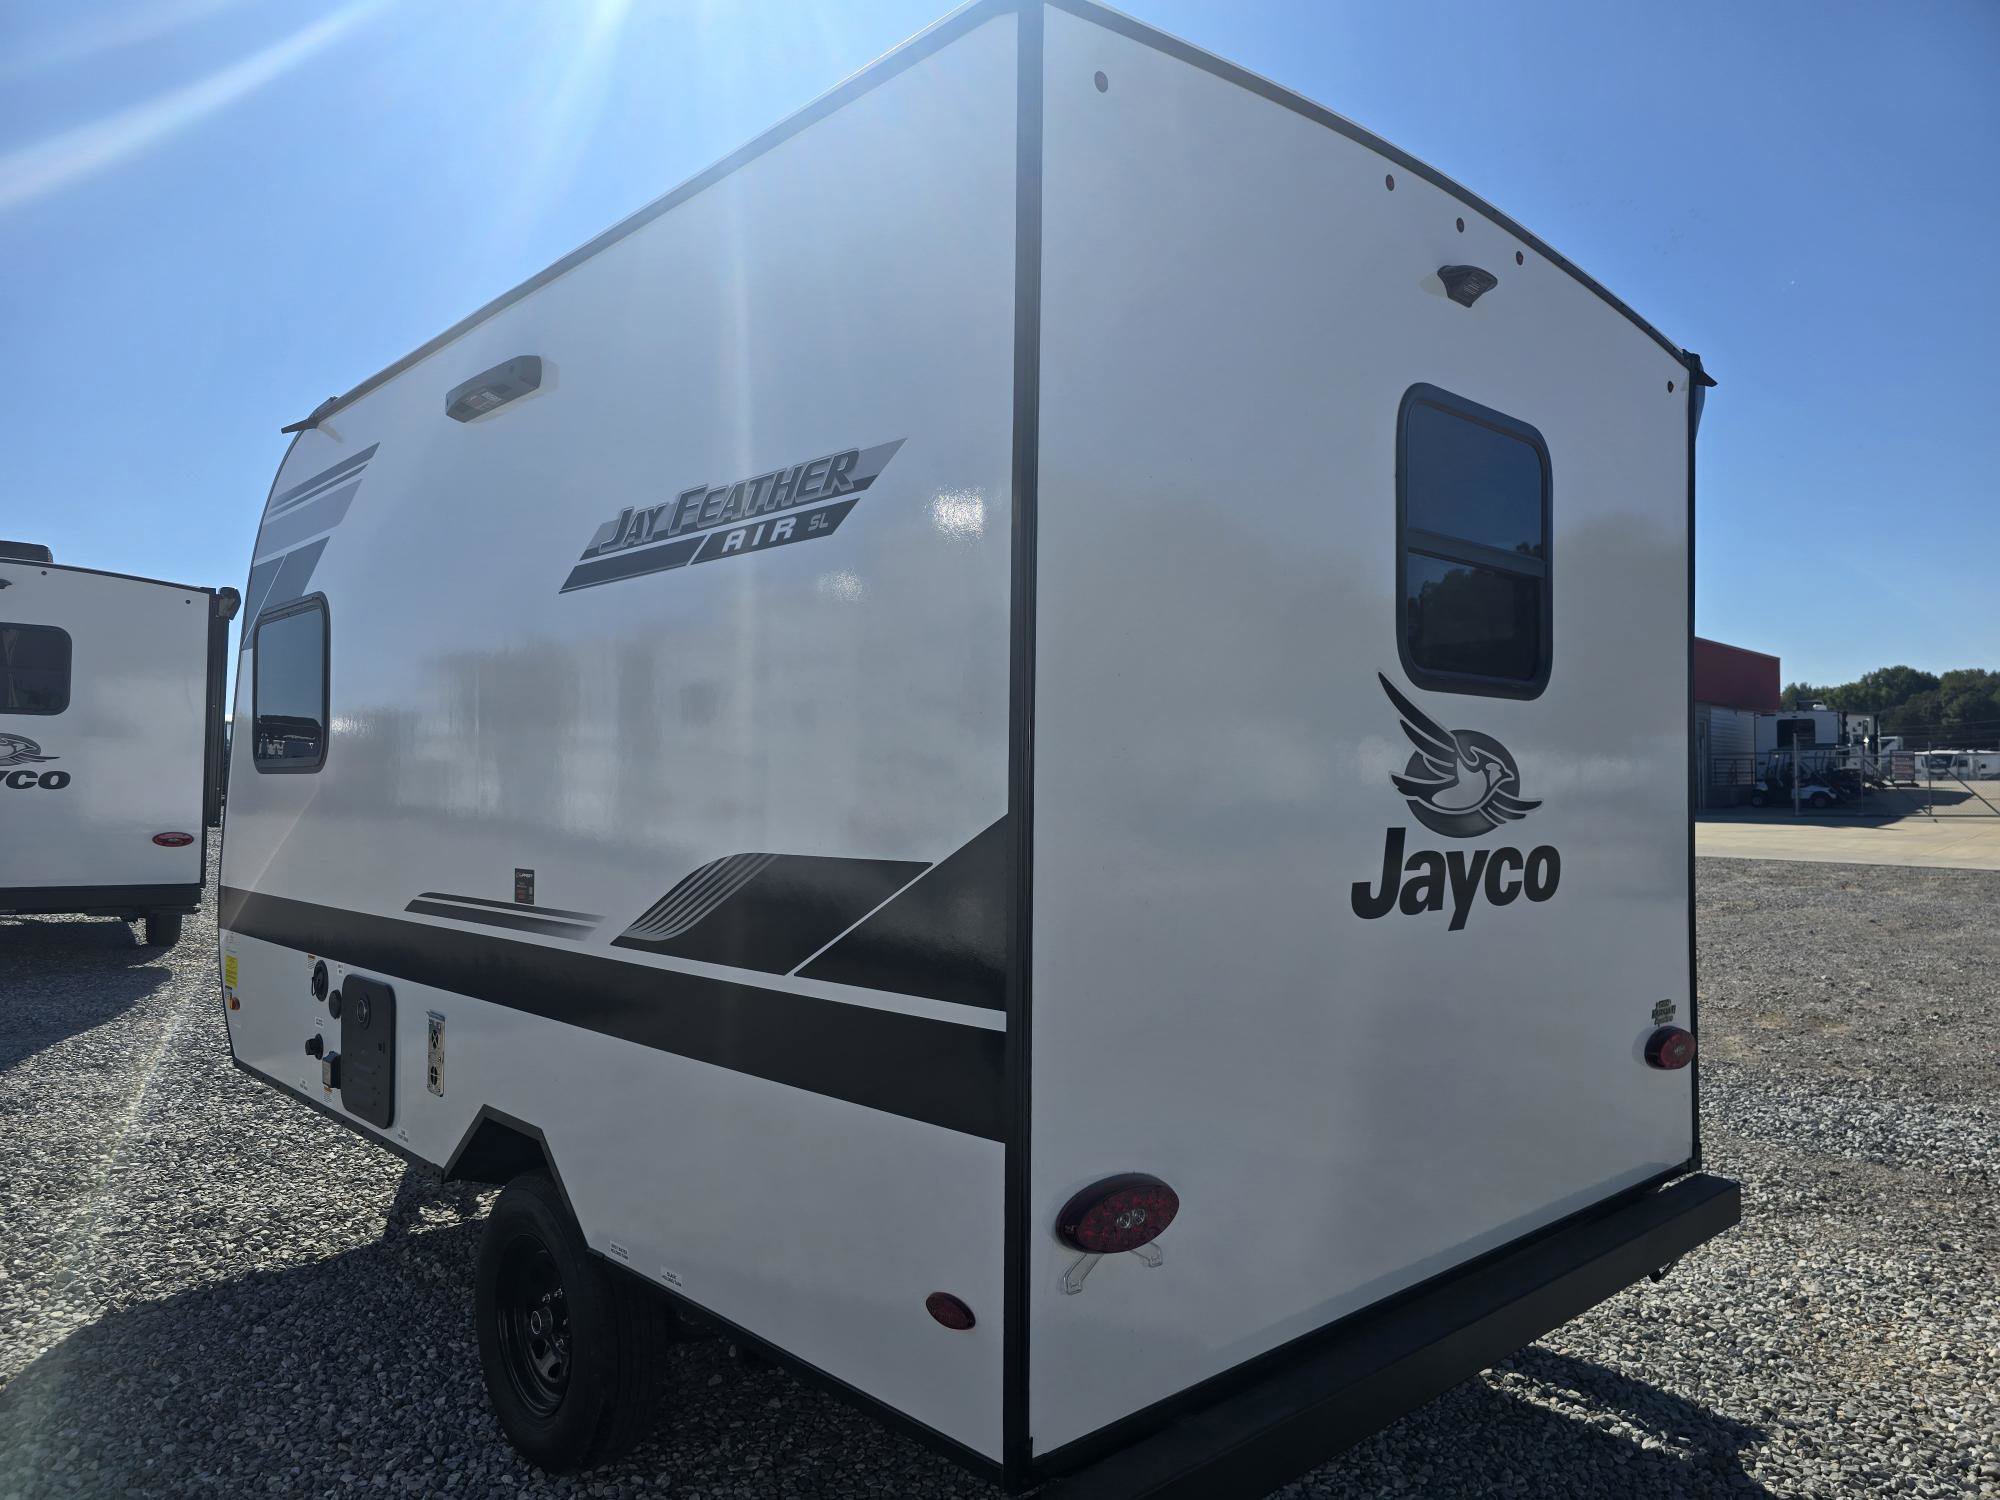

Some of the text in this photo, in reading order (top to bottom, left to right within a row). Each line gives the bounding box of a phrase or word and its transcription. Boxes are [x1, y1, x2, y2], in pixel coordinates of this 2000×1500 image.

[599, 447, 861, 553] JAY FEATHER
[720, 513, 829, 555] AIR SL
[0, 770, 72, 790] co
[1350, 826, 1562, 932] Jayco
